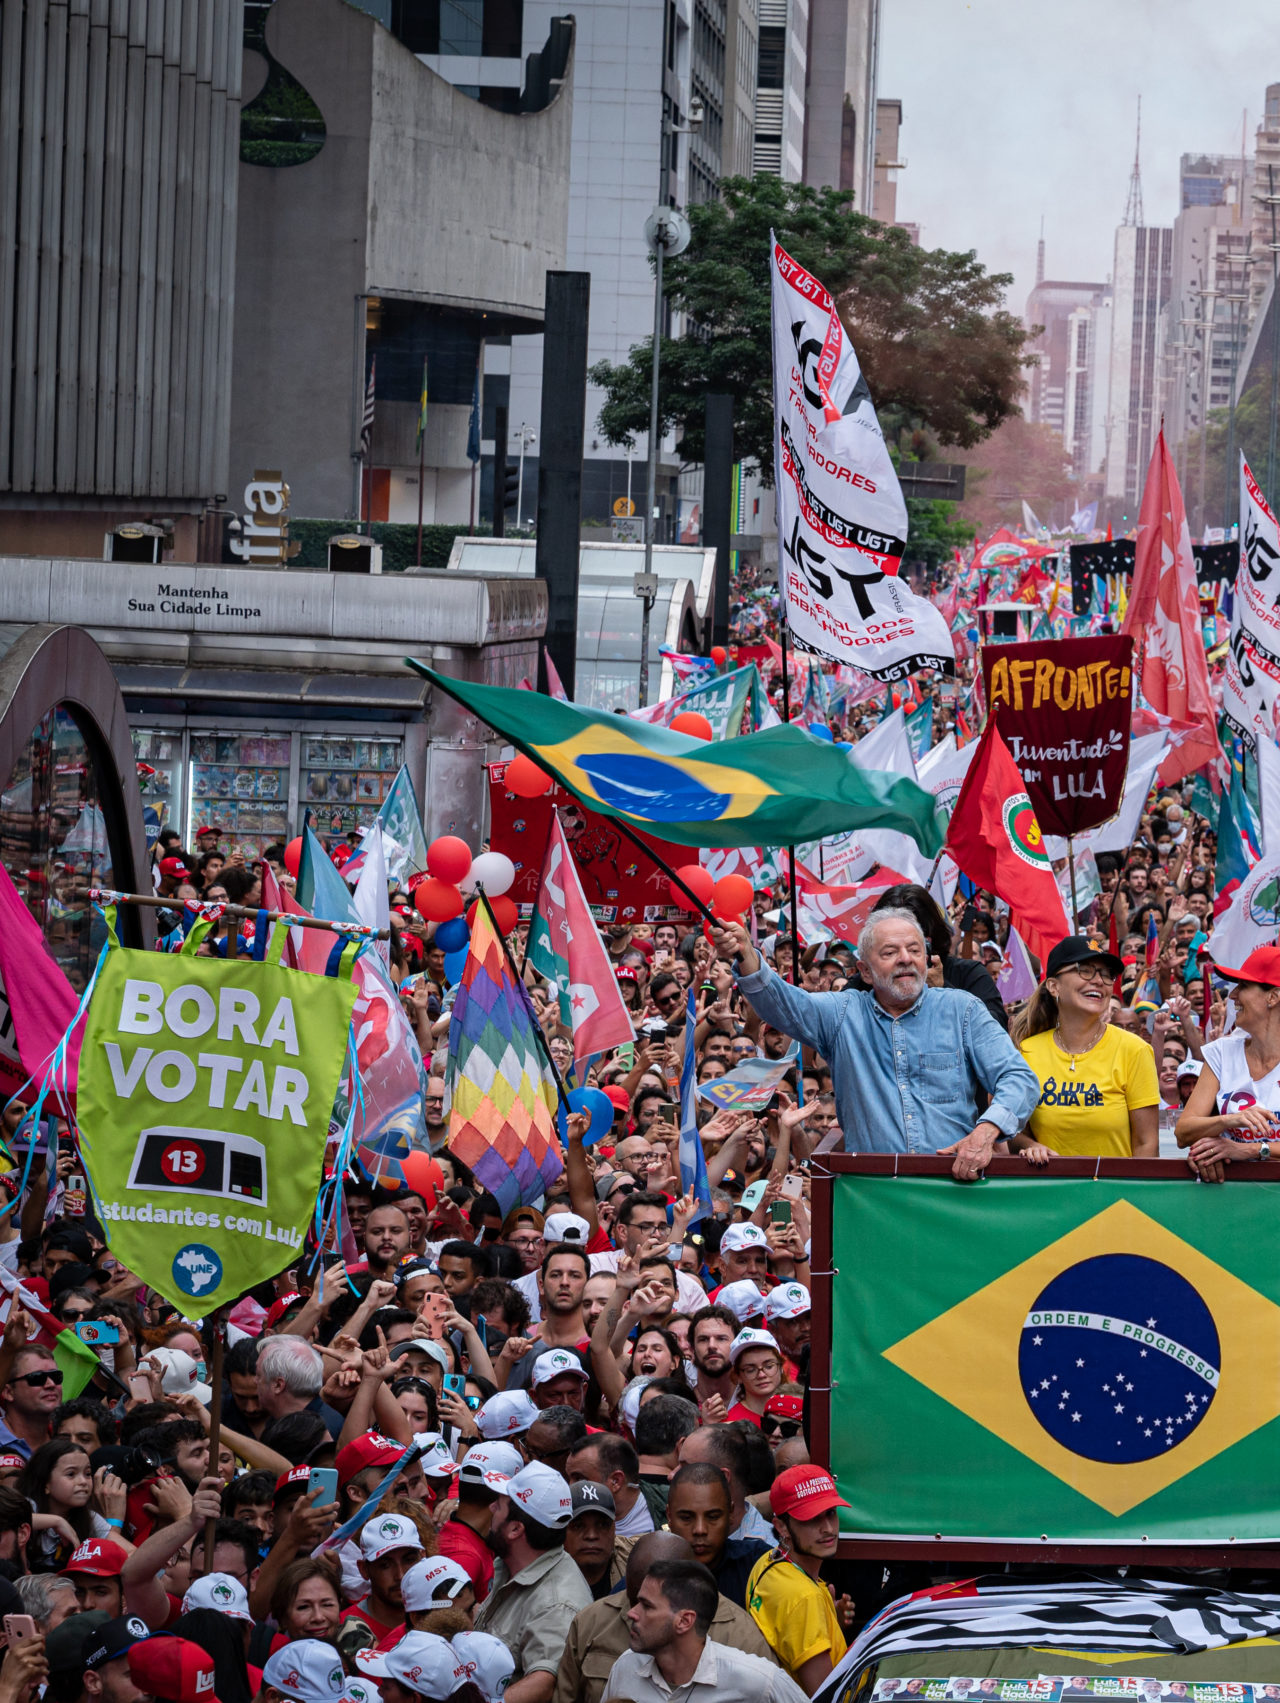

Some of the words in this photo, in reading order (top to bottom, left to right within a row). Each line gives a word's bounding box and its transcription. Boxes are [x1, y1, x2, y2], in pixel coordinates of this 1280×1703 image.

[777, 252, 797, 278] UGT
[795, 274, 821, 300] UGT
[827, 512, 854, 538] UGT
[857, 530, 895, 554] UGT
[157, 583, 229, 600] Mantenha
[127, 598, 155, 613] Sua
[160, 600, 212, 616] Cidade
[216, 602, 262, 620] Limpa
[877, 656, 913, 683] UGT
[916, 656, 947, 674] UGT
[990, 656, 1131, 712] AFRONTE!
[1007, 736, 1112, 763] Juventude
[117, 979, 300, 1056] BORA
[103, 1042, 309, 1127] VOTAR
[1061, 1082, 1098, 1096] LULA
[1221, 1091, 1257, 1117] 13
[167, 1149, 198, 1174] 13
[224, 1213, 264, 1238] com
[190, 1264, 213, 1276] UNE
[1031, 1313, 1090, 1327] ORDEM
[1102, 1318, 1112, 1331] E
[1123, 1323, 1215, 1381] PROGRESSO
[468, 1453, 489, 1464] MST
[288, 1466, 310, 1480] Lul
[582, 1485, 599, 1500] NY
[794, 1480, 810, 1493] LULA
[797, 1488, 818, 1499] GOSTOSO
[72, 1545, 102, 1561] LULA
[424, 1565, 448, 1582] MST
[1003, 1681, 1029, 1691] Lula
[1028, 1680, 1055, 1694] 13
[1093, 1679, 1120, 1690] Lula
[1193, 1685, 1218, 1694] Lula
[1218, 1683, 1245, 1695] 13
[1001, 1690, 1051, 1700] Haddad
[1194, 1692, 1244, 1703] Haddad
